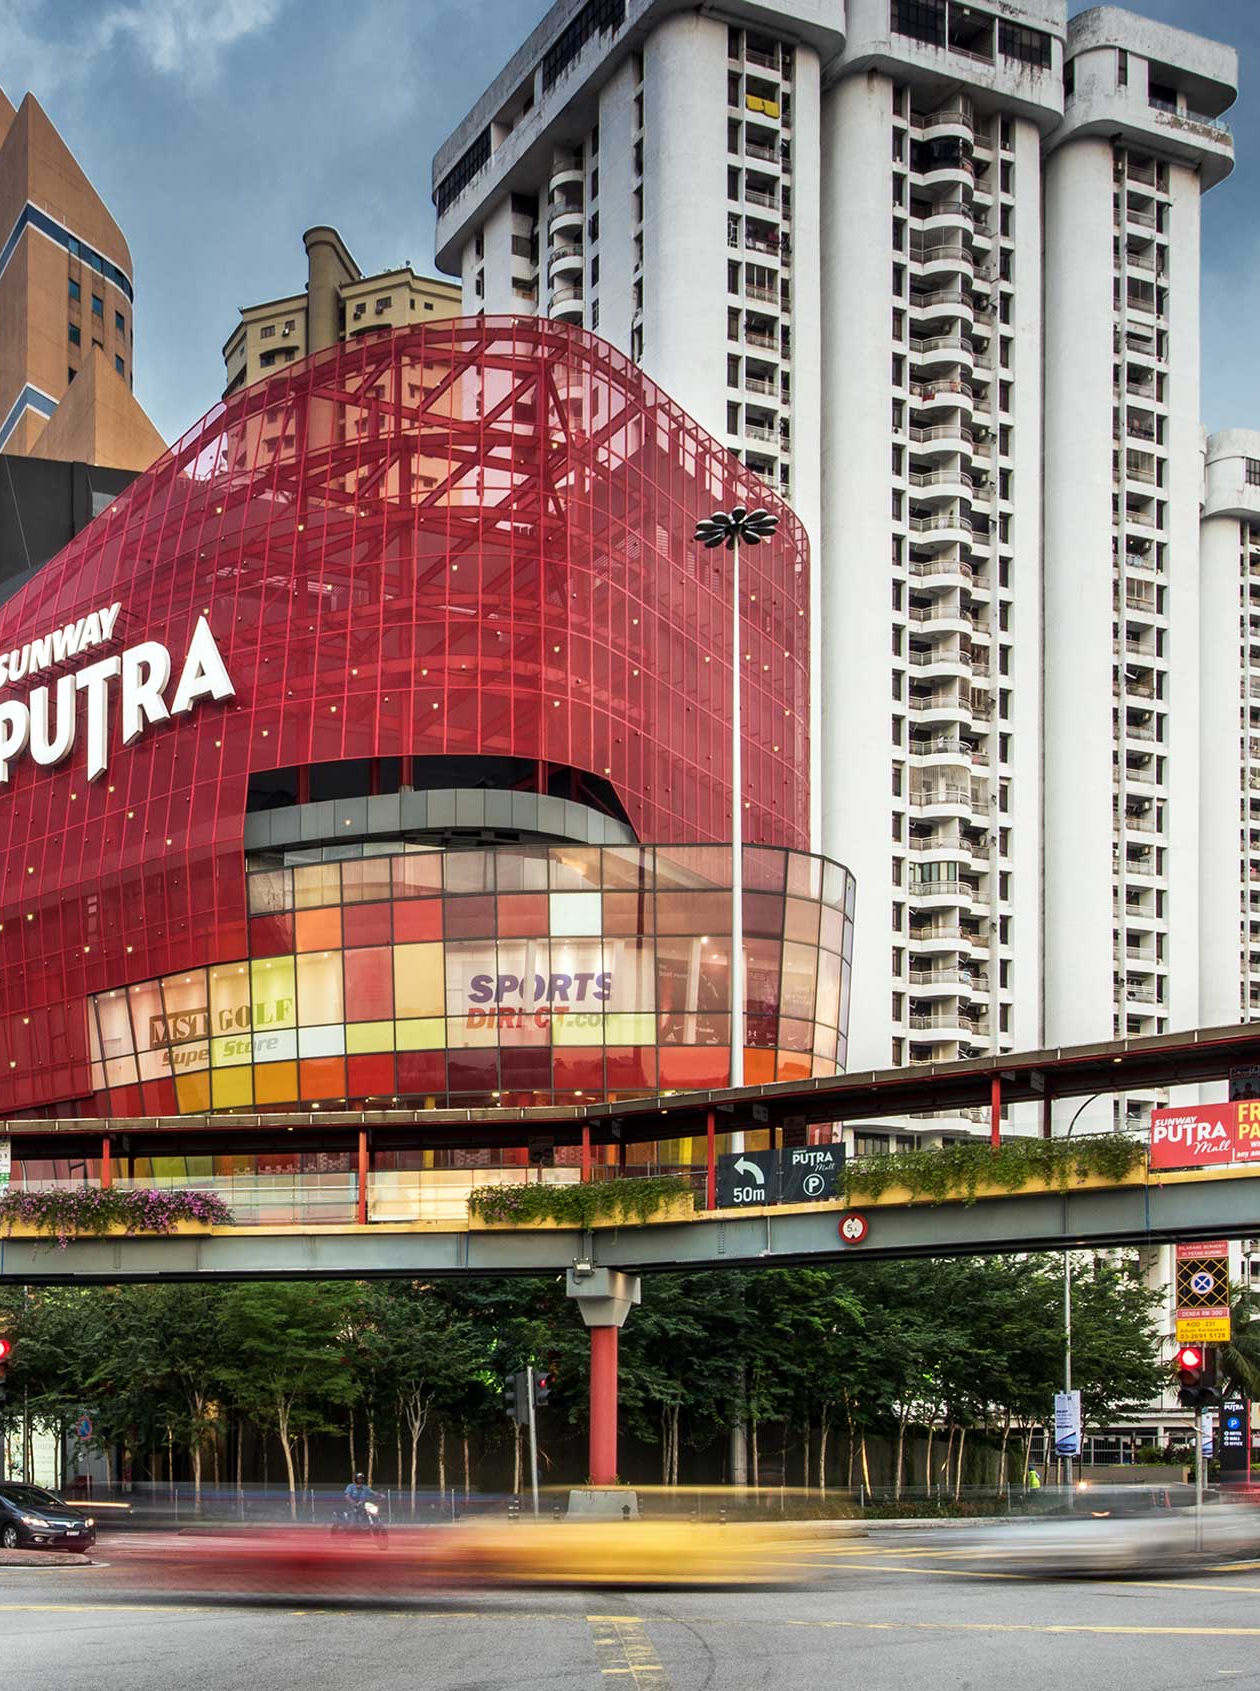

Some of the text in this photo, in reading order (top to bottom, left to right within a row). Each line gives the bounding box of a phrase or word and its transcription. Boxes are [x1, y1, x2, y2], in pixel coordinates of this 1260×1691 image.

[468, 972, 613, 1004] SPORTS
[152, 998, 293, 1045] MST GOLF
[223, 1036, 279, 1058] Store
[1155, 1116, 1197, 1127] SUNWAY
[1153, 1121, 1227, 1147] PUTRA
[1194, 1140, 1231, 1155] Mall
[792, 1151, 833, 1167] PUTRA
[815, 1163, 836, 1172] Mall
[808, 1177, 820, 1193] P
[733, 1187, 765, 1203] 50m
[1223, 1404, 1244, 1412] PUTRA
